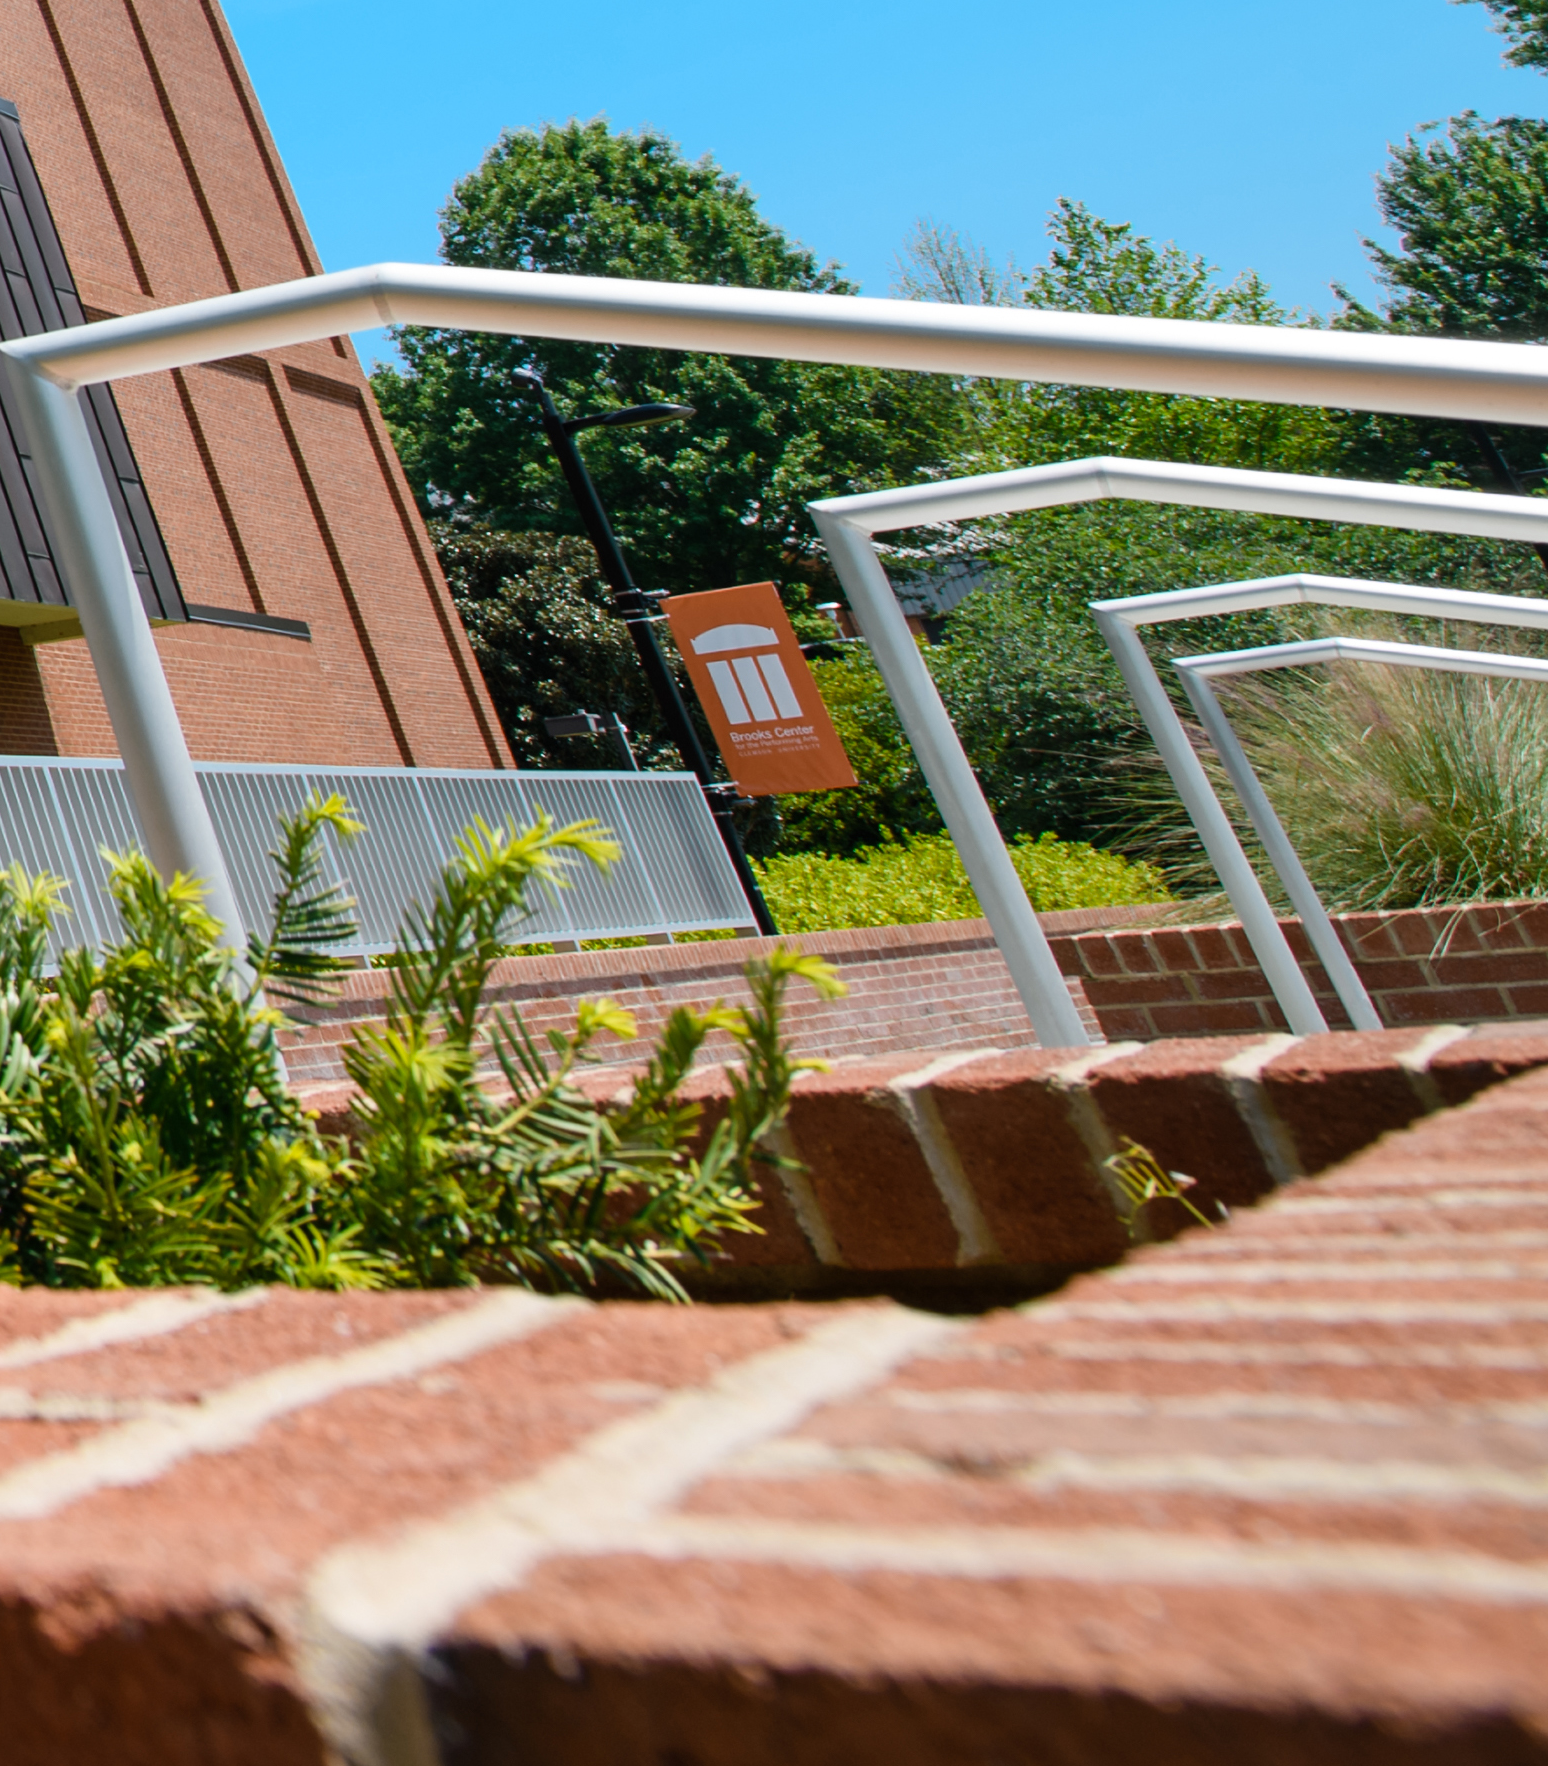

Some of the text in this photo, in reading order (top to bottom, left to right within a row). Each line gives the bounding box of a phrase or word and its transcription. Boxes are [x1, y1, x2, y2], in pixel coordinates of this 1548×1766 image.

[729, 725, 814, 743] Brooks Center
[746, 741, 759, 749] the
[760, 737, 802, 747] Performing
[802, 735, 819, 743] Arts
